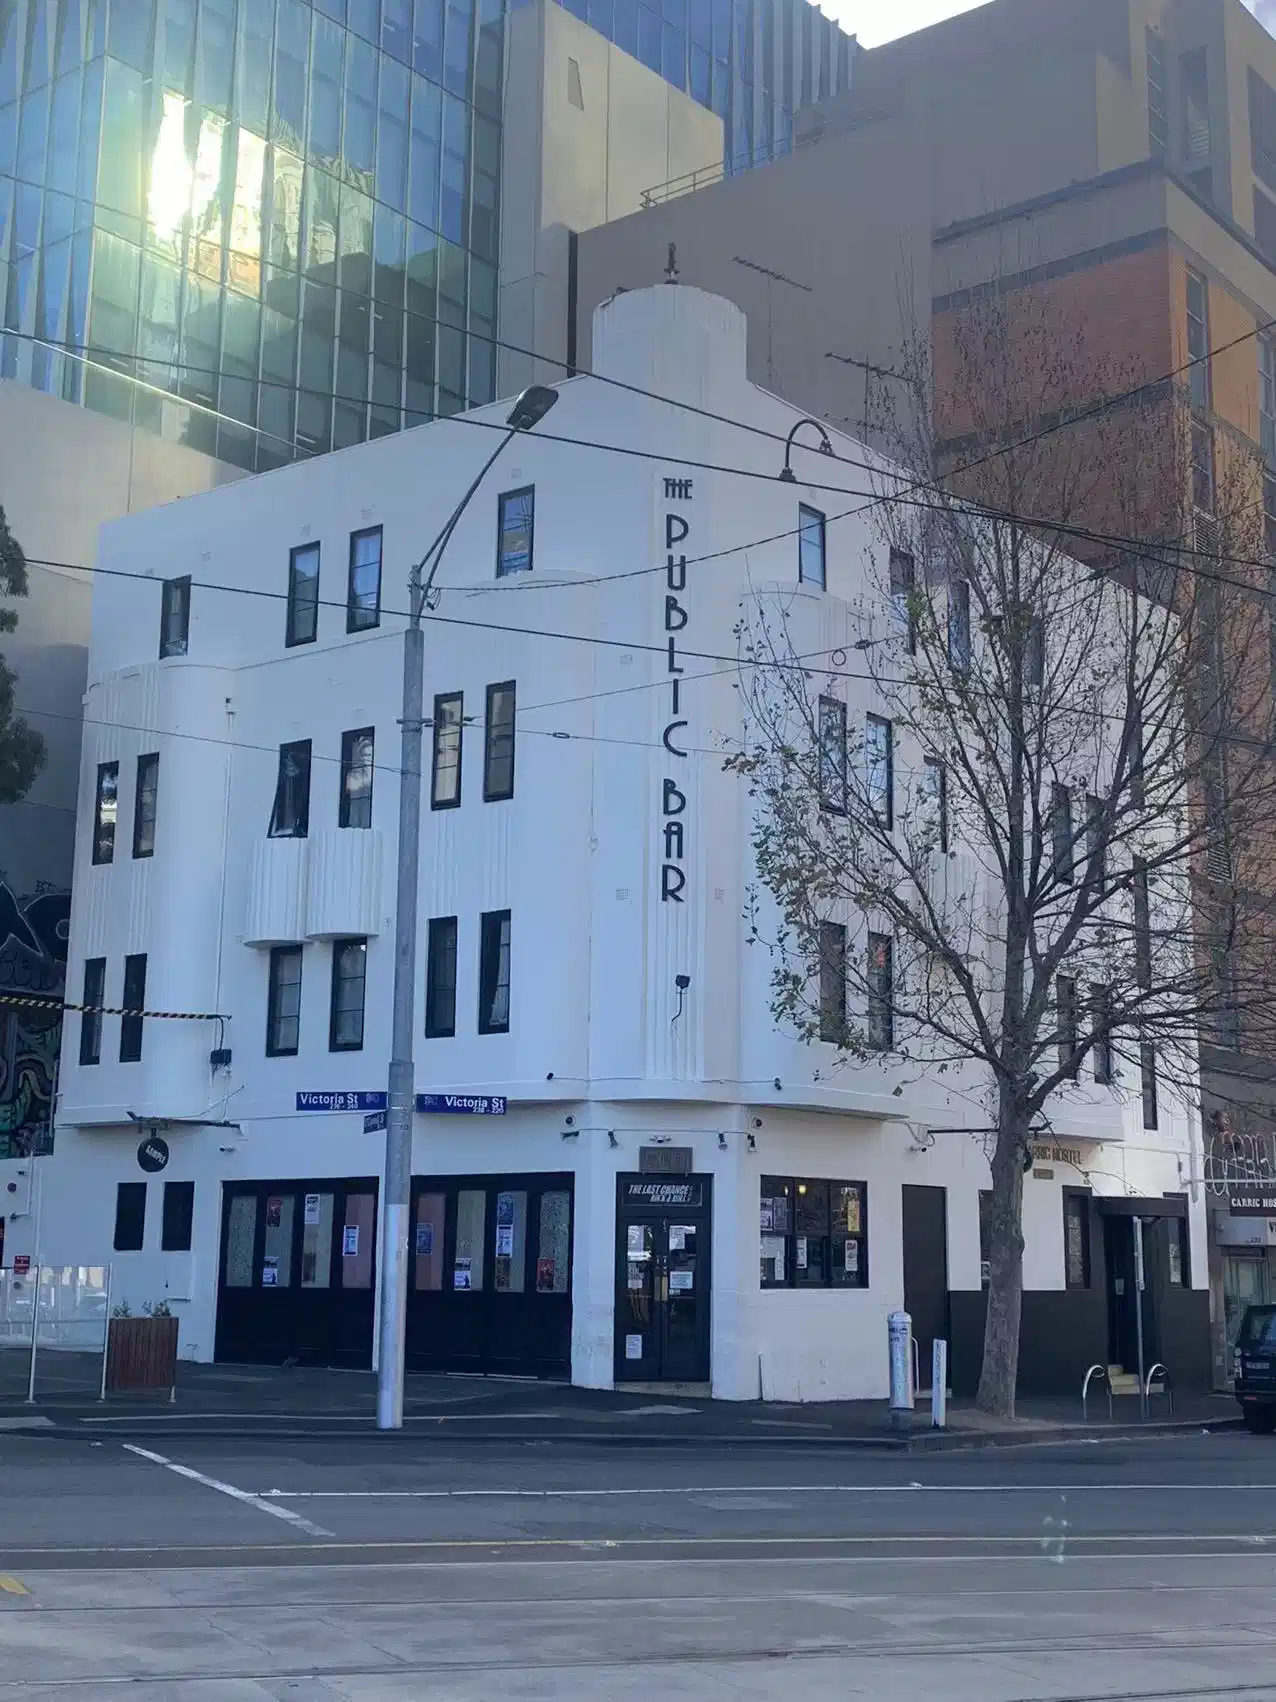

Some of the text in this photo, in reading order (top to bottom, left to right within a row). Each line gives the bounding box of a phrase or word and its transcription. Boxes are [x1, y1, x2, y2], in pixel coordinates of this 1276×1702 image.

[662, 477, 693, 500] THE
[662, 513, 690, 758] PUBLIC
[661, 778, 686, 902] BAR
[300, 1093, 359, 1105] Victoria St
[445, 1096, 504, 1109] Victoria St
[628, 1184, 643, 1195] THE
[642, 1184, 661, 1195] LAST
[1231, 1197, 1260, 1208] CARRIC
